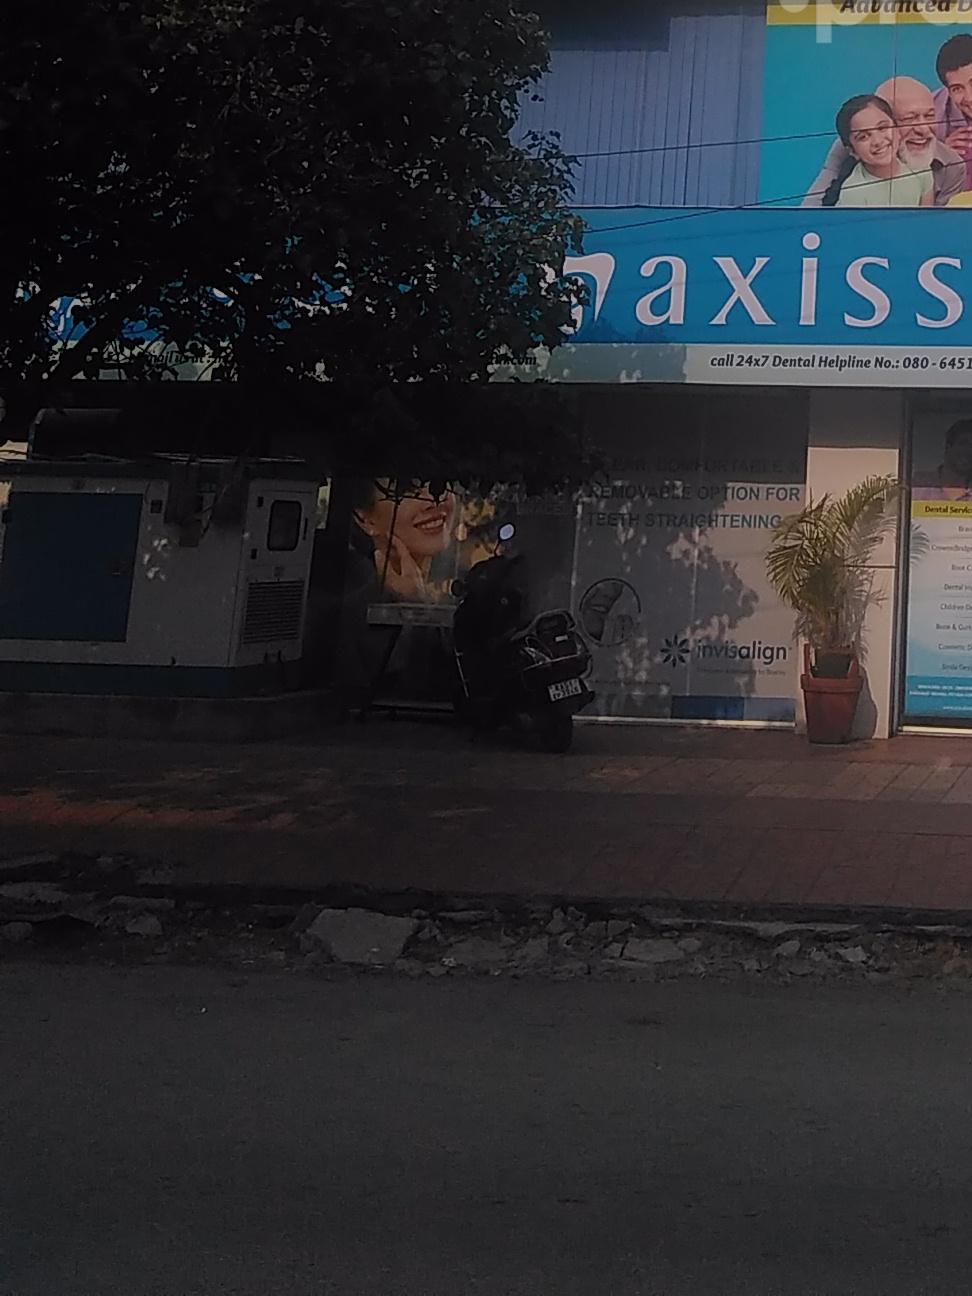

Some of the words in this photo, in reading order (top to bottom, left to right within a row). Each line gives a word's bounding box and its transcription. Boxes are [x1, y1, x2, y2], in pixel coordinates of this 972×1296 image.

[634, 232, 965, 328] axiss
[710, 353, 734, 367] call
[735, 354, 769, 367] 24x7
[771, 354, 815, 368] Dental
[817, 354, 871, 372] Helpline
[874, 356, 900, 369] No.:
[902, 356, 929, 369] 080
[590, 483, 692, 500] REMOVABLE
[697, 485, 760, 501] OPTION
[766, 486, 800, 502] FOR
[925, 505, 948, 513] Dental
[588, 512, 639, 527] TEETH
[695, 640, 788, 665] invisalign
